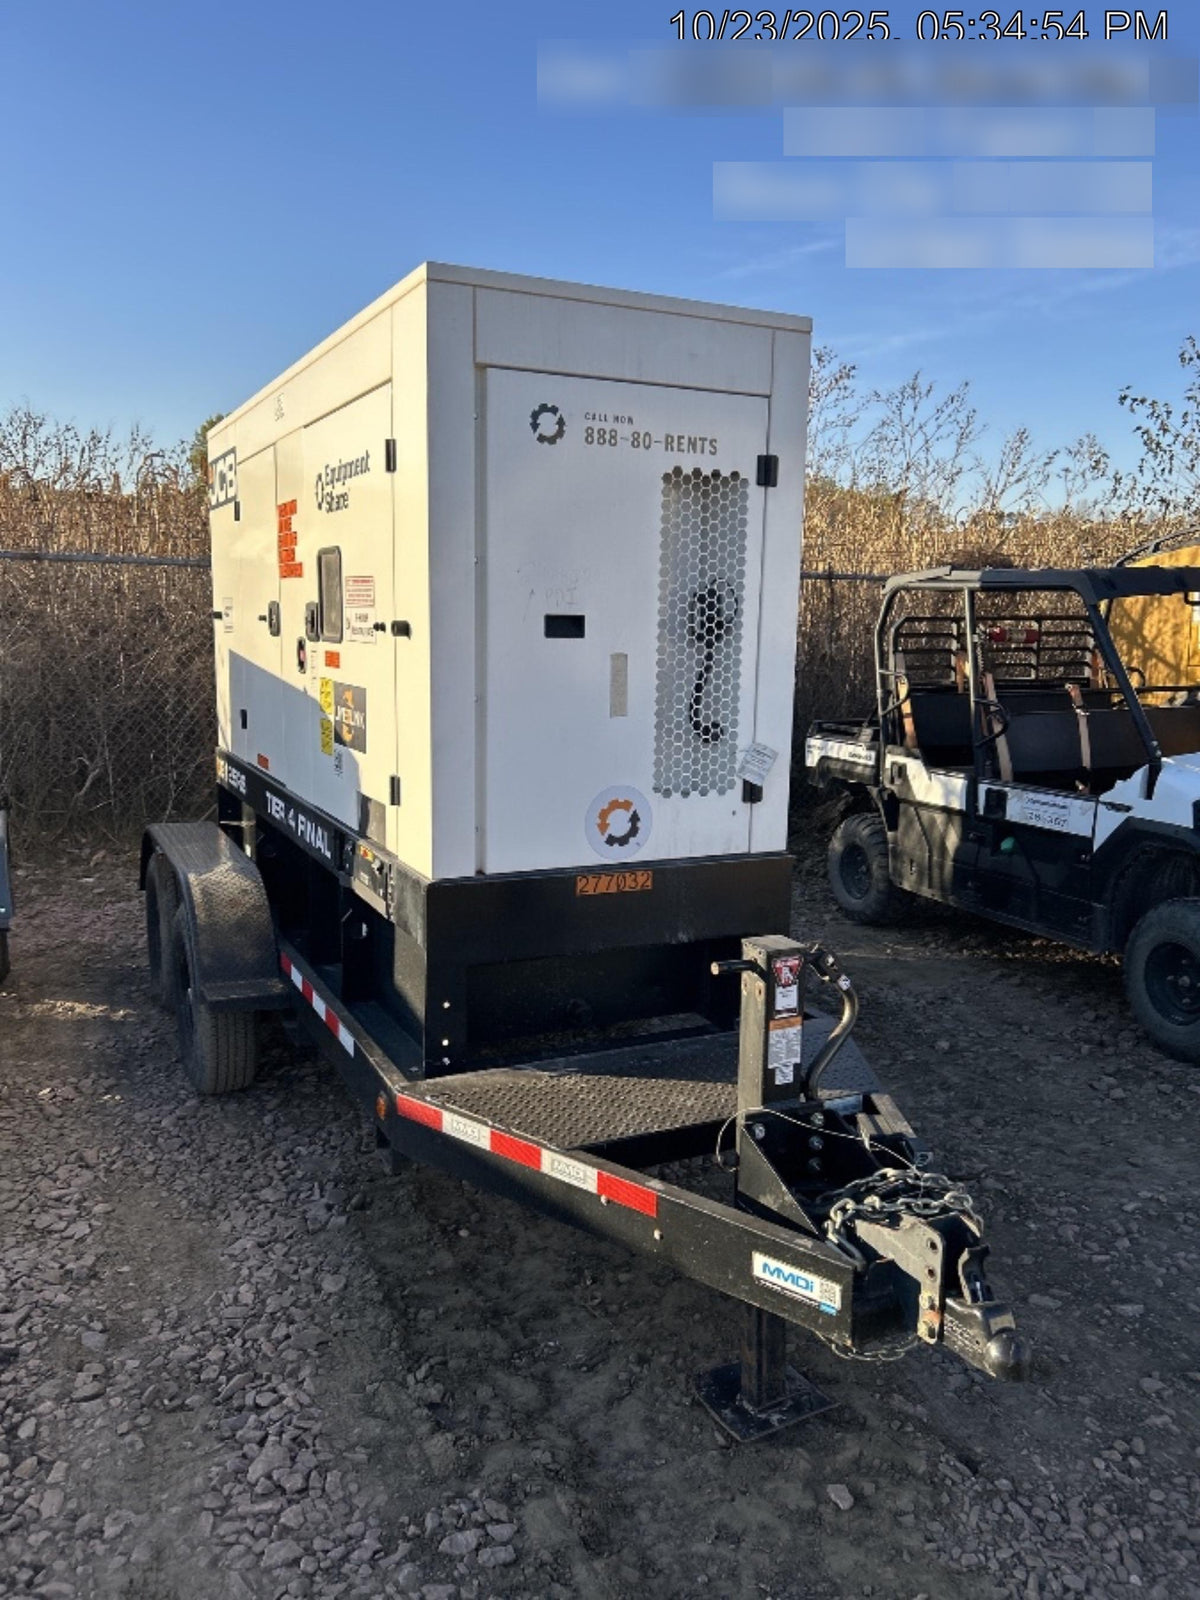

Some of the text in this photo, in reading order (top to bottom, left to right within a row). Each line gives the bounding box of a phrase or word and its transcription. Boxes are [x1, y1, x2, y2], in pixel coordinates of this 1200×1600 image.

[584, 411, 608, 422] CALL
[584, 426, 718, 456] 888-80-RENTS
[324, 449, 370, 490] Equipment
[325, 490, 349, 513] Share
[266, 789, 331, 860] TIER 4 FINAL
[578, 871, 651, 894] 277032
